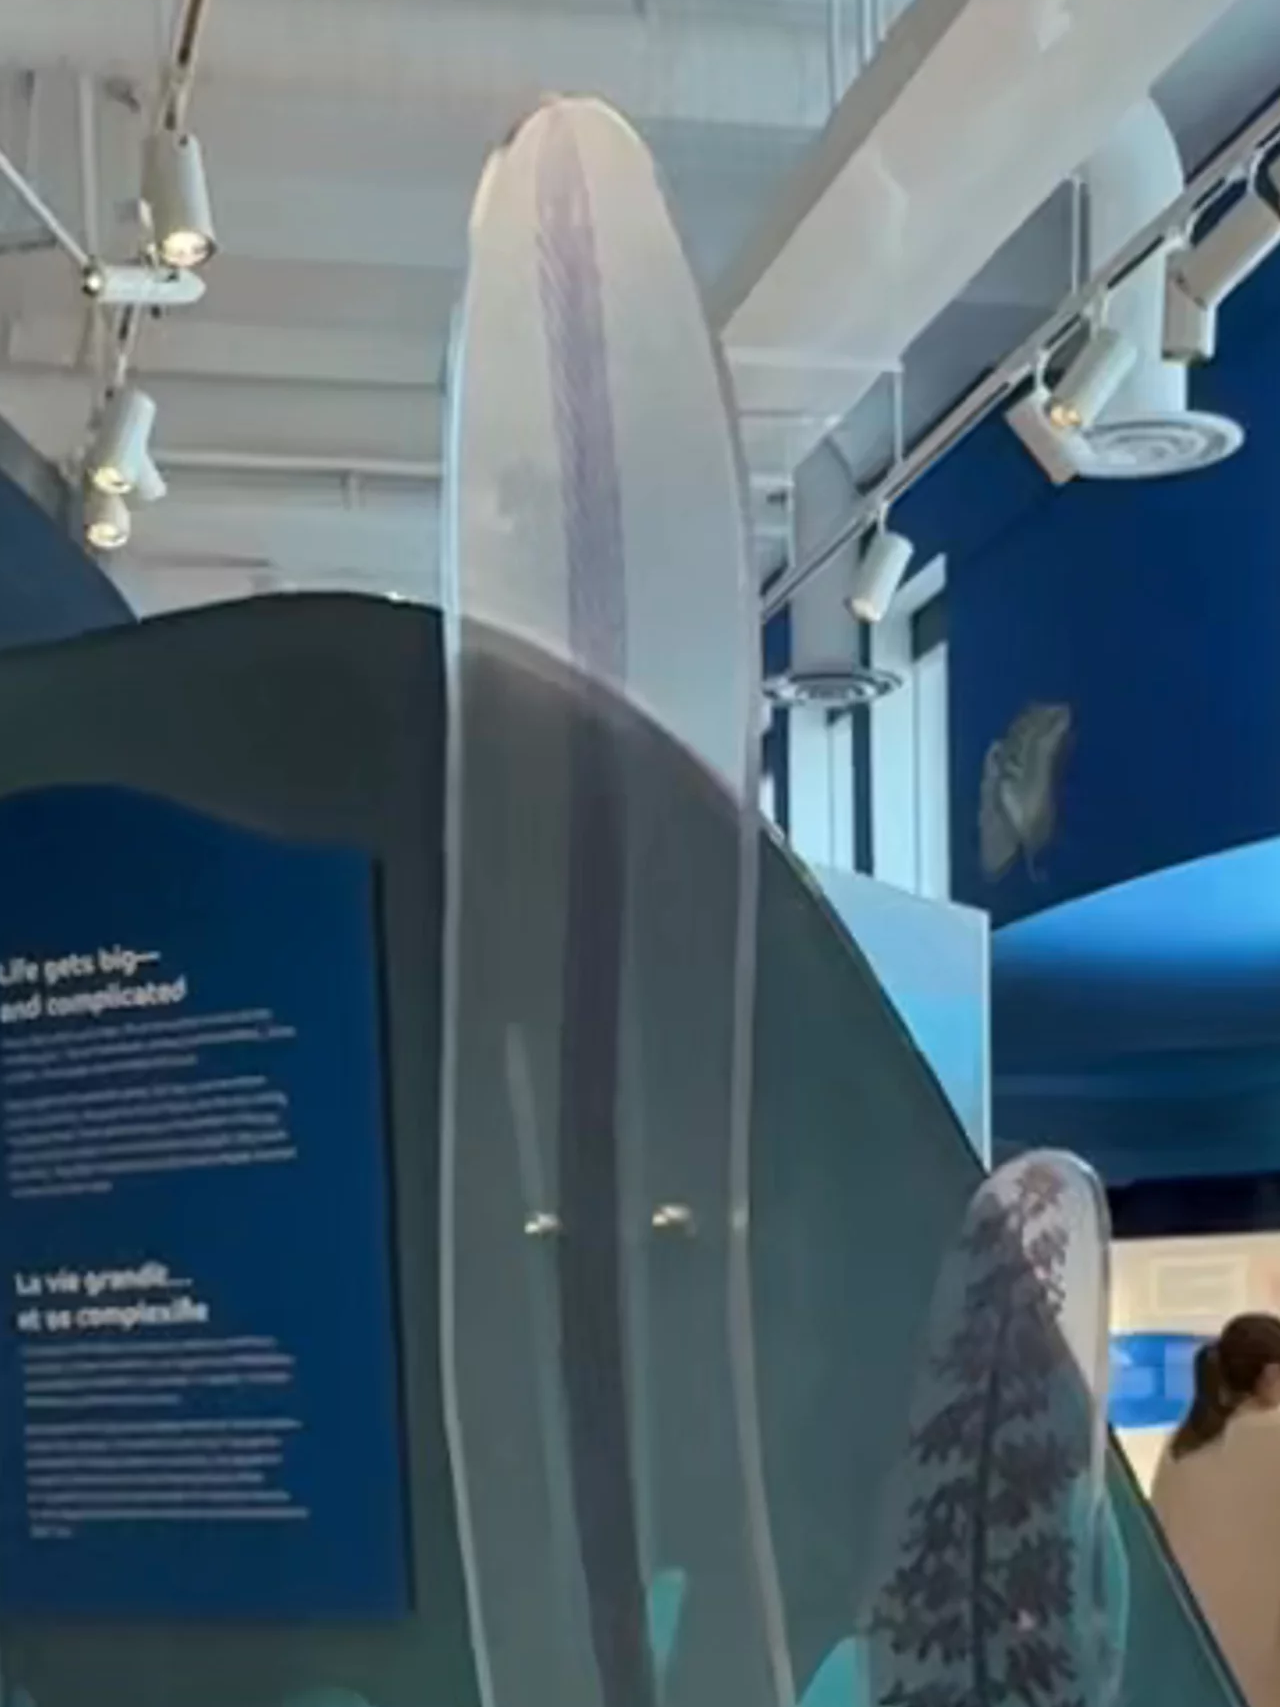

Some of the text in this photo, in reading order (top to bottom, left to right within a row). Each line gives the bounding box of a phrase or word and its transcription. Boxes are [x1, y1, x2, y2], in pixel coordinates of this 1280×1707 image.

[43, 952, 95, 985] gets
[46, 974, 188, 1016] complicated
[14, 1272, 42, 1296] La
[44, 1267, 79, 1294] vie
[16, 1307, 41, 1332] et
